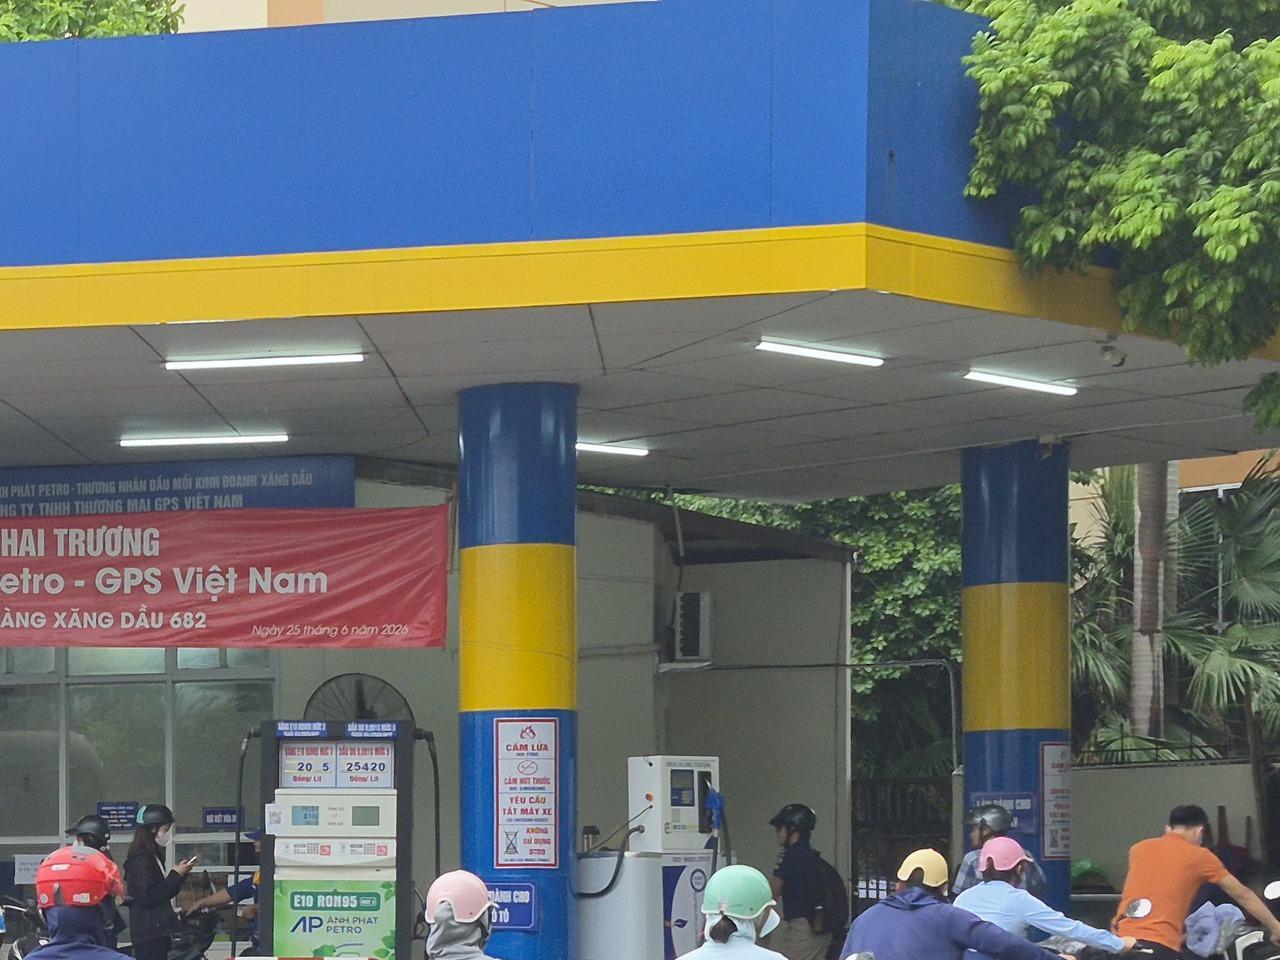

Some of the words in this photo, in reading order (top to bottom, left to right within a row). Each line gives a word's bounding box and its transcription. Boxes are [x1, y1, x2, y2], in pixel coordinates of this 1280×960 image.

[20, 502, 35, 516] TY
[39, 501, 70, 515] TNHH
[154, 497, 179, 511] GPS
[213, 494, 243, 508] NAM
[53, 525, 160, 557] TRƯƠNG
[95, 566, 162, 595] GPS
[172, 564, 237, 602] Việt
[248, 566, 328, 594] Nam
[53, 607, 114, 629] XĂNG
[120, 603, 163, 629] DẦU
[170, 611, 207, 629] 682
[286, 624, 301, 636] 25
[341, 624, 349, 636] 6
[381, 623, 409, 636] 2026
[346, 762, 386, 772] 25420
[290, 916, 324, 933] AP
[326, 926, 362, 934] PETRO
